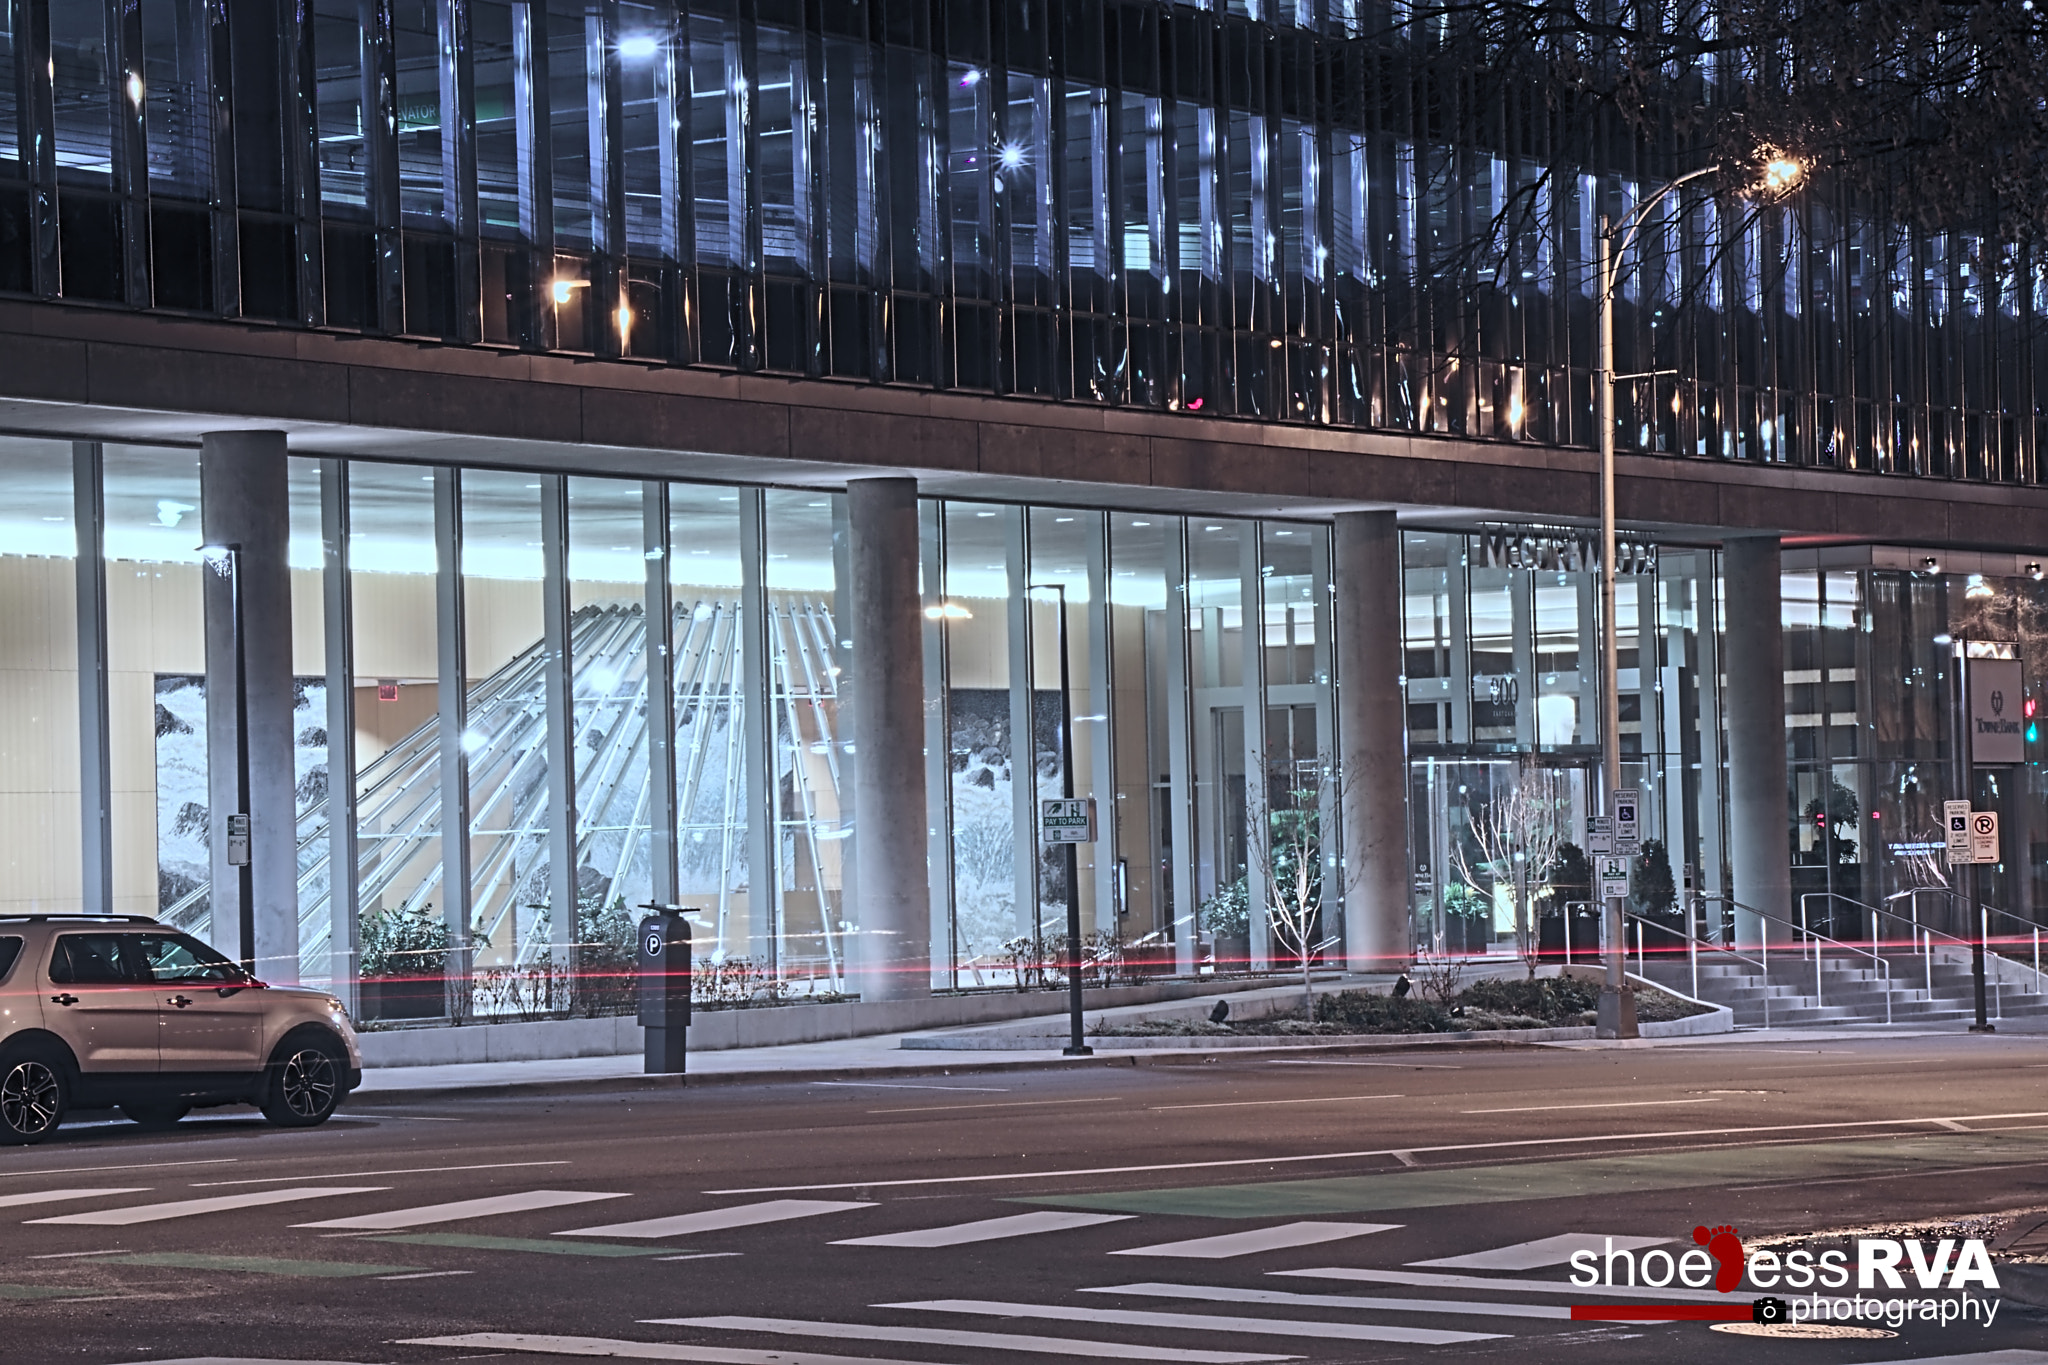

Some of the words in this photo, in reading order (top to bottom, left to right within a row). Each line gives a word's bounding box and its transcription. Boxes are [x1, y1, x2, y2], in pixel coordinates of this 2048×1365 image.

[1044, 817, 1057, 825] PAY
[1058, 817, 1067, 825] TO
[1068, 817, 1086, 825] PARK
[650, 937, 659, 952] P
